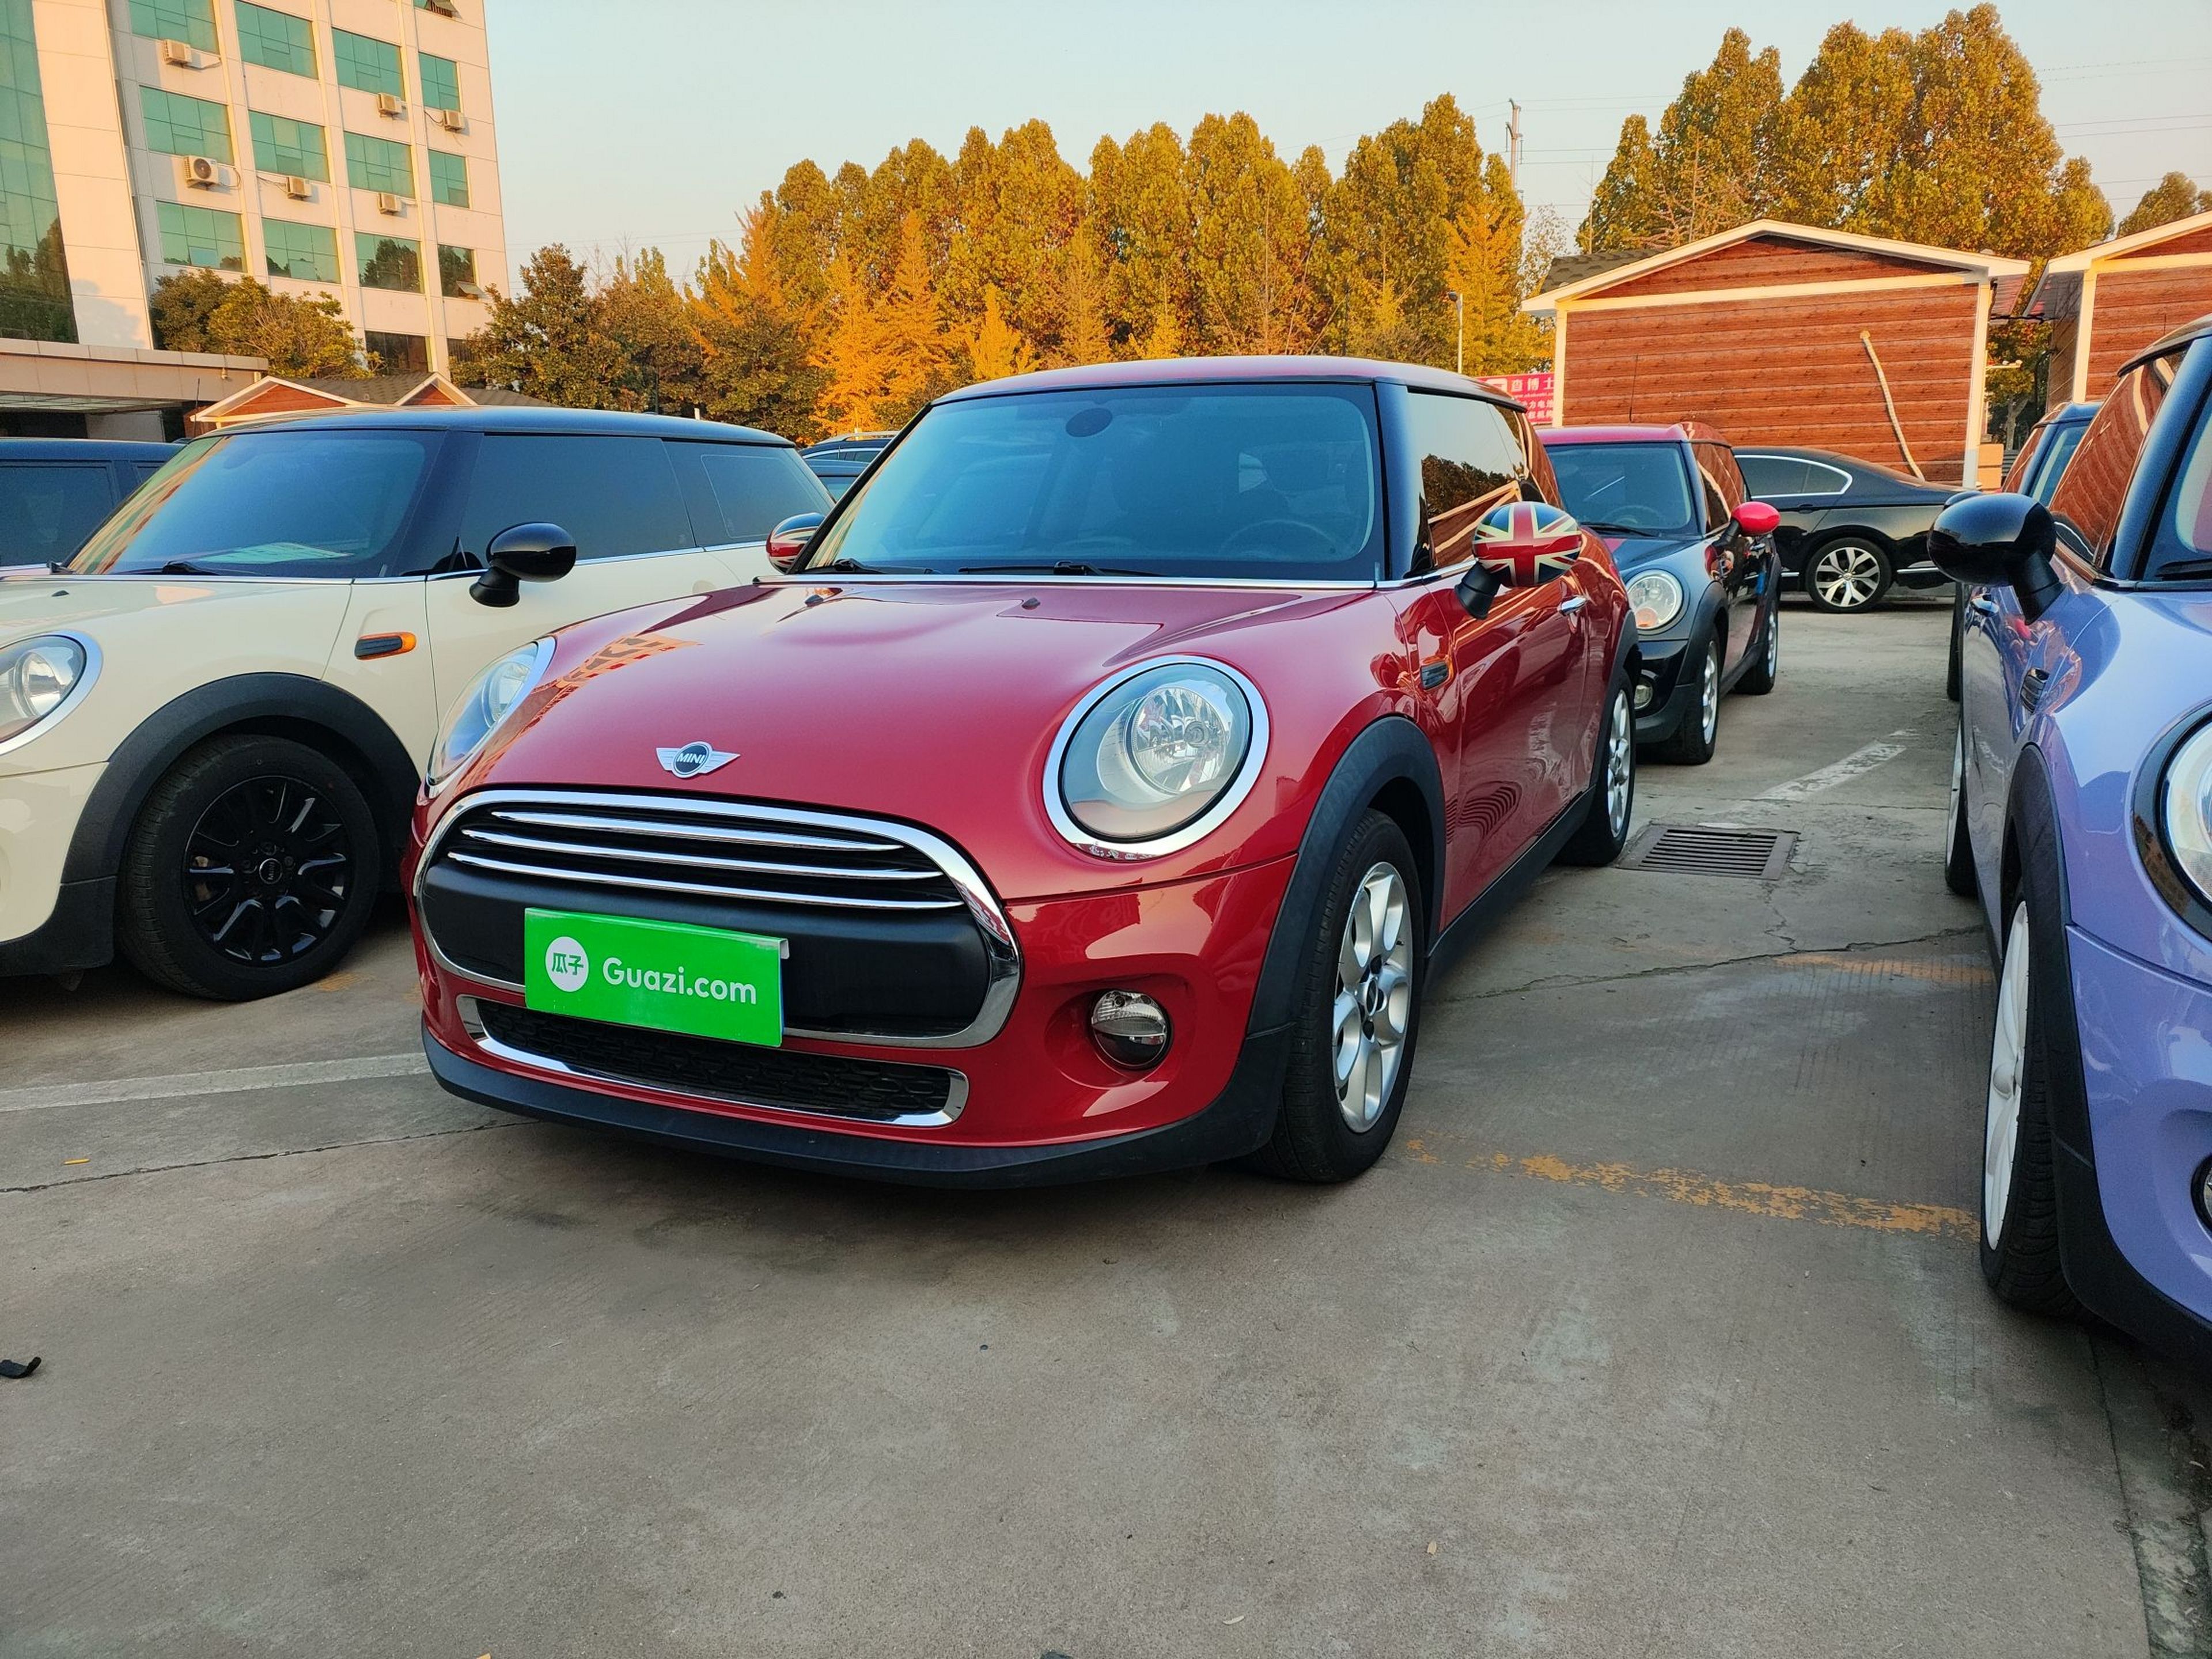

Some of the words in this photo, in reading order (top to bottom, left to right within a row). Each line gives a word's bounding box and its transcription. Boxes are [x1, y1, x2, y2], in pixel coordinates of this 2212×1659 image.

[676, 753, 705, 764] MINI
[551, 952, 584, 976] 瓜子
[603, 957, 756, 1004] Guazi.com
